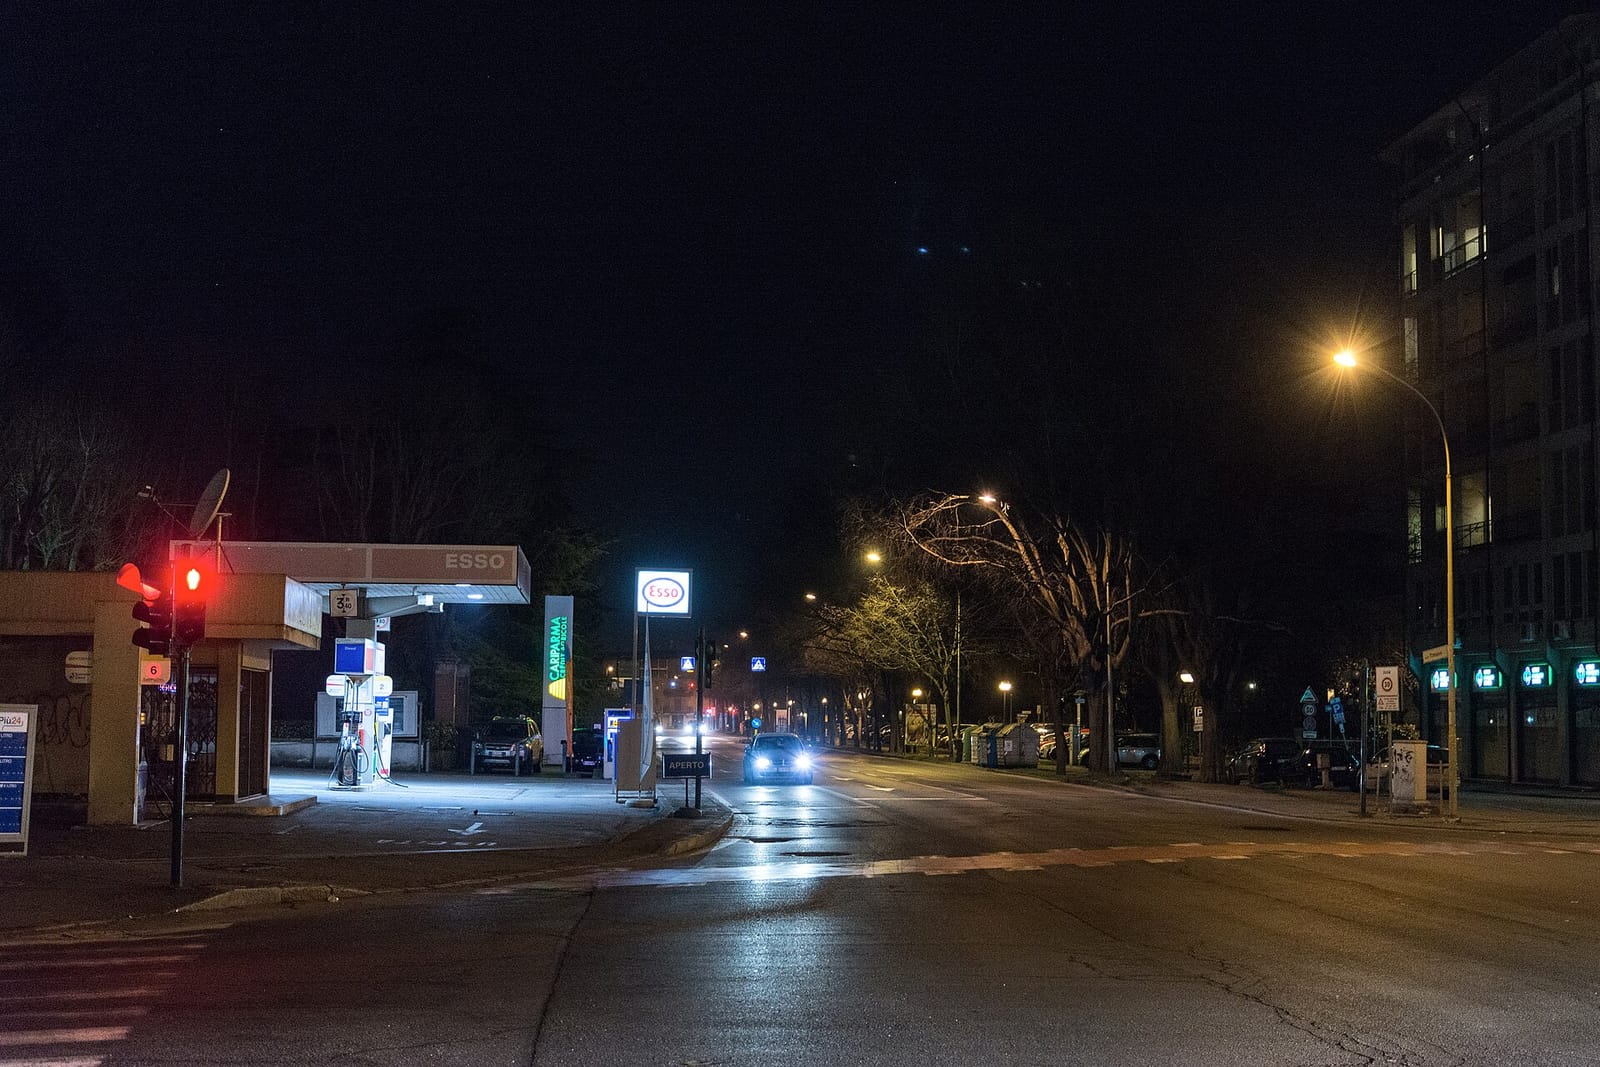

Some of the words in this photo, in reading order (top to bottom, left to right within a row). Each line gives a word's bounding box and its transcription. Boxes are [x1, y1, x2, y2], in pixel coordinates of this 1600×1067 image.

[446, 554, 505, 569] ESSO
[649, 585, 679, 598] Esso
[549, 616, 561, 681] CARIPARMA
[150, 666, 157, 675] 6
[669, 761, 704, 769] APERTO
